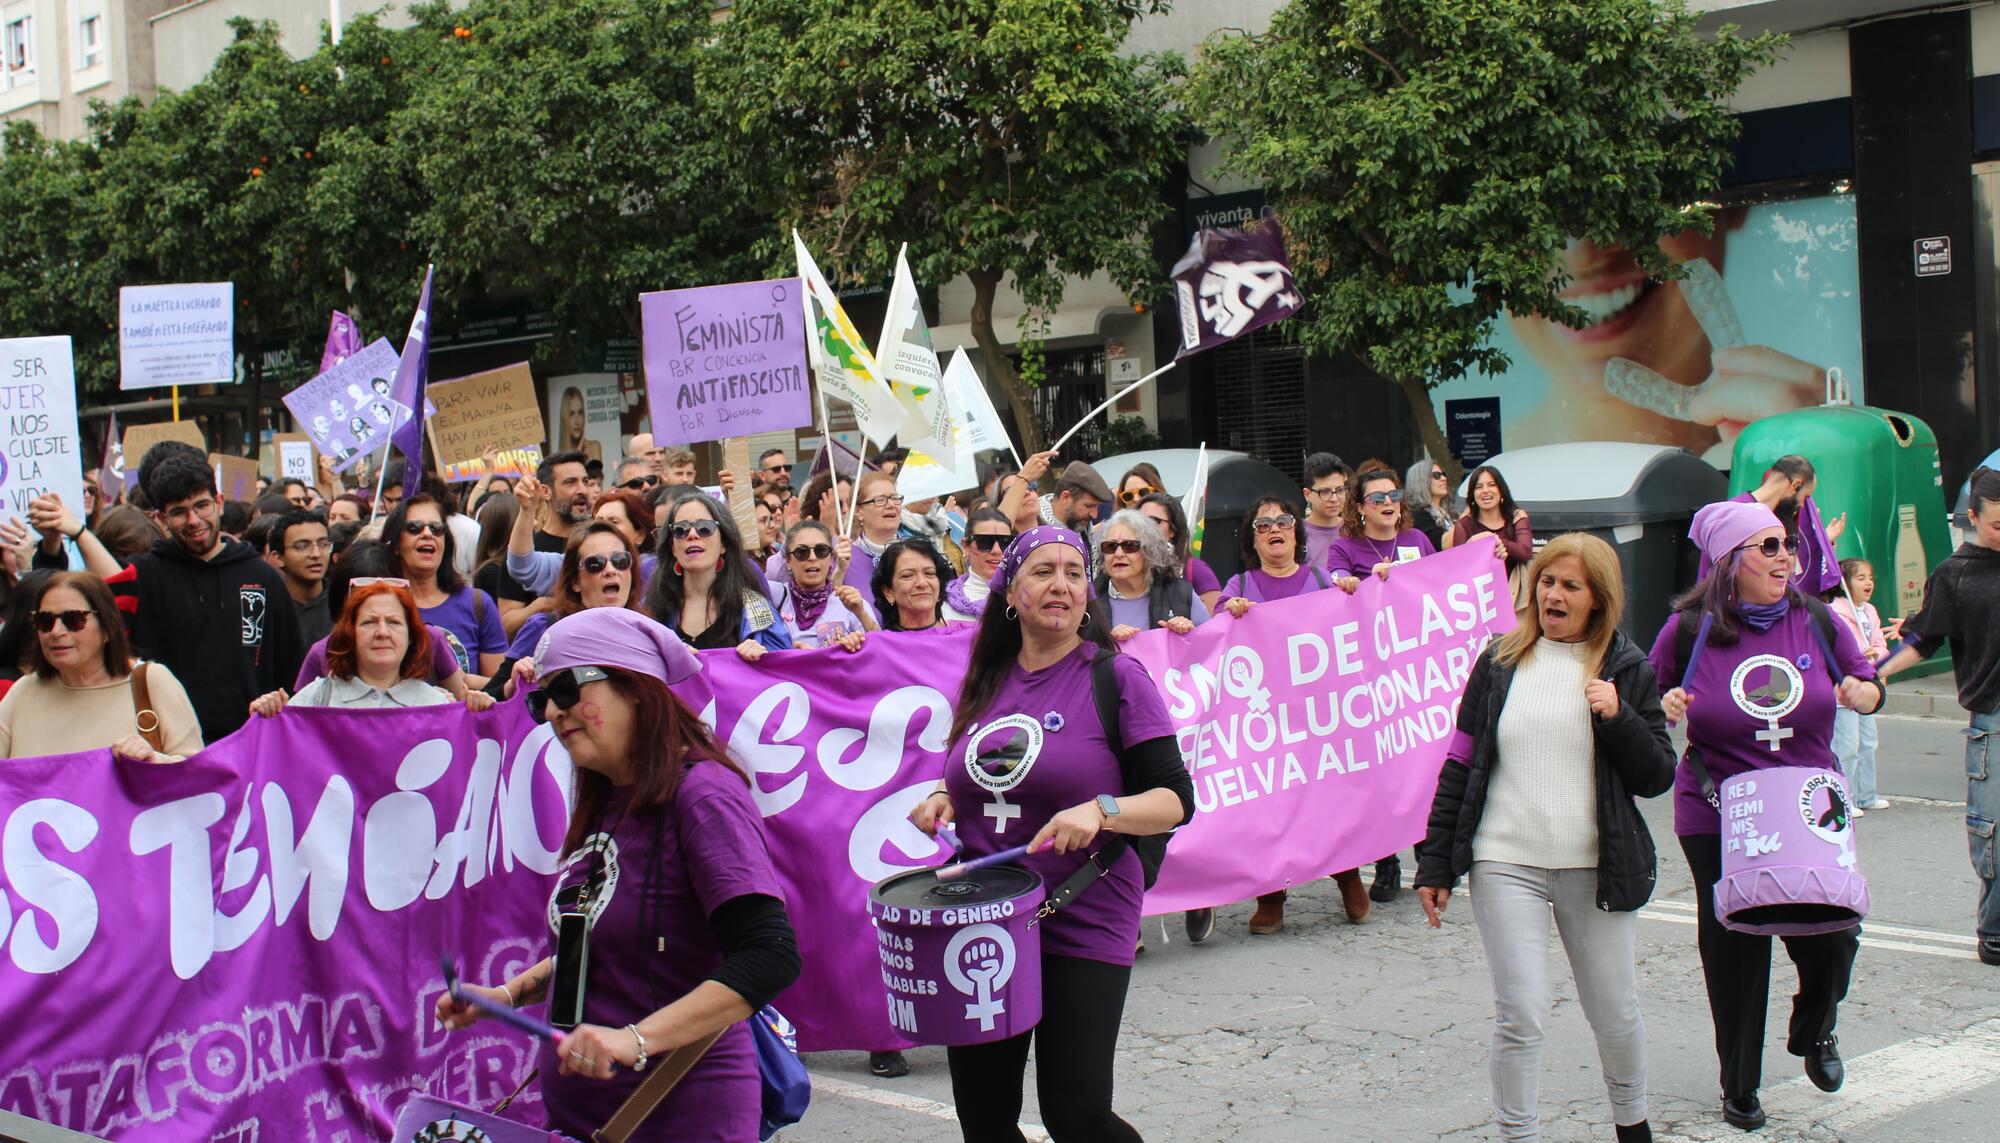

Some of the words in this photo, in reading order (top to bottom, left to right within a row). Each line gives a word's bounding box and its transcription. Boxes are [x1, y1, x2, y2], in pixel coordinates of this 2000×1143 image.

[1196, 206, 1253, 227] vivanta
[674, 304, 784, 355] FEMINISTA
[11, 357, 48, 378] SER
[669, 356, 695, 379] POR
[703, 351, 767, 373] CONCIENCIA
[0, 383, 46, 411] JER
[676, 364, 802, 411] ANTIFASCISTA
[10, 414, 49, 437] NOS
[440, 416, 456, 428] EL
[679, 412, 705, 435] POR
[441, 430, 467, 446] HAY
[472, 424, 499, 440] QUE
[8, 436, 70, 459] CUESTE
[455, 448, 468, 460] EL
[19, 461, 43, 482] LA
[288, 457, 305, 468] NO
[1287, 621, 1364, 687] DE
[1373, 573, 1498, 662] CLASE
[1316, 738, 1370, 781] AL
[1727, 781, 1757, 800] RED
[1728, 799, 1764, 820] FEMI
[1802, 808, 1817, 827] NO
[1731, 817, 1756, 836] NIS
[909, 909, 932, 926] DE
[941, 900, 1015, 926] GENERO
[887, 992, 918, 1033] 8M
